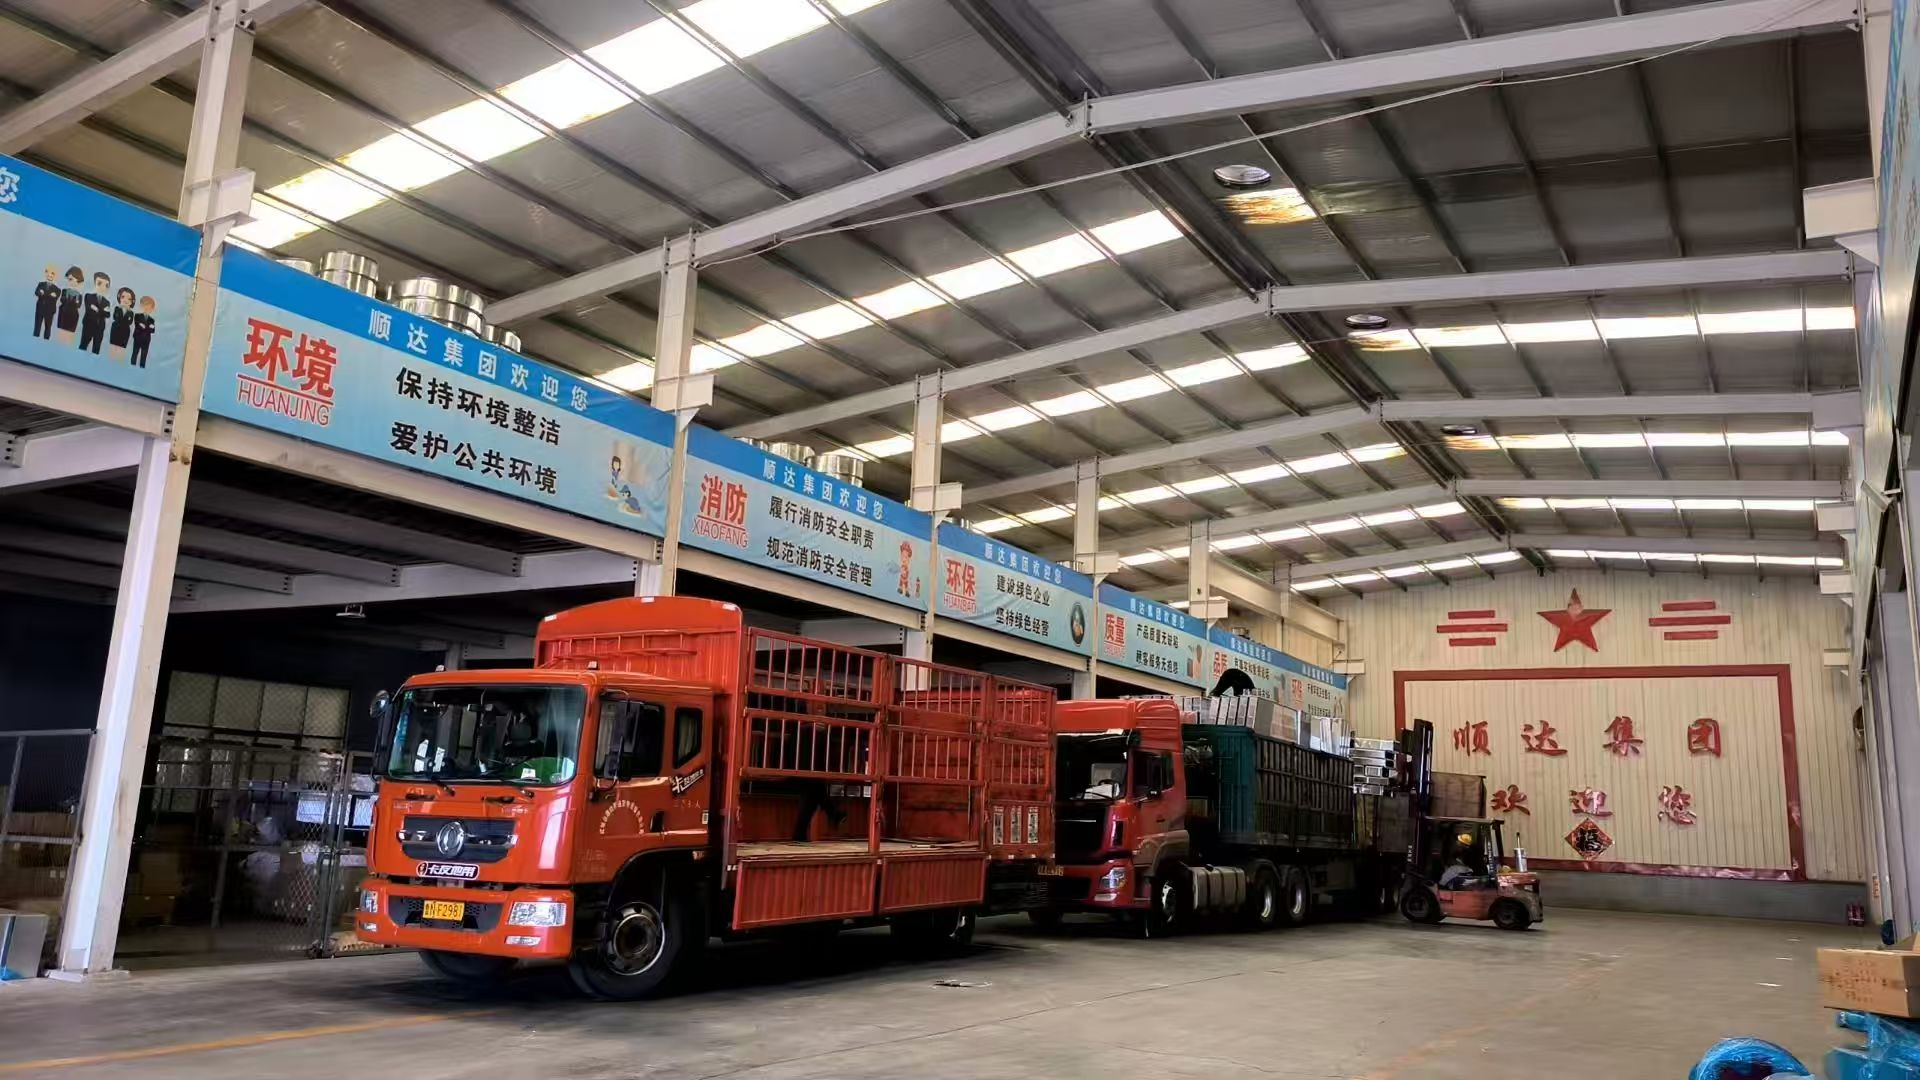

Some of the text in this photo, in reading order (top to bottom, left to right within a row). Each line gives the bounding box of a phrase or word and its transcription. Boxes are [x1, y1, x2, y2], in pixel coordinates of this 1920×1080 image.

[243, 317, 337, 398] 环境
[368, 308, 589, 411] 顺达集团欢迎您
[238, 380, 330, 426] HUANJING
[396, 366, 561, 445] 保持环境整洁
[390, 421, 557, 495] 爱护公共环境
[700, 474, 748, 525] 消防
[763, 458, 885, 521] 顺达集团欢迎您
[691, 517, 749, 549] XIAOFANG
[769, 496, 875, 550] 履行消防安全职责
[766, 536, 873, 587] 规范消防安全管理
[946, 559, 976, 597] 环保
[984, 542, 1063, 585] 顺达集团欢迎您
[996, 574, 1051, 607] 建设绿色企业
[995, 607, 1050, 637] 坚持绿色经营
[1104, 613, 1125, 644] 质量
[1453, 715, 1722, 758] 顺达集团
[1491, 783, 1697, 826] 欢迎您
